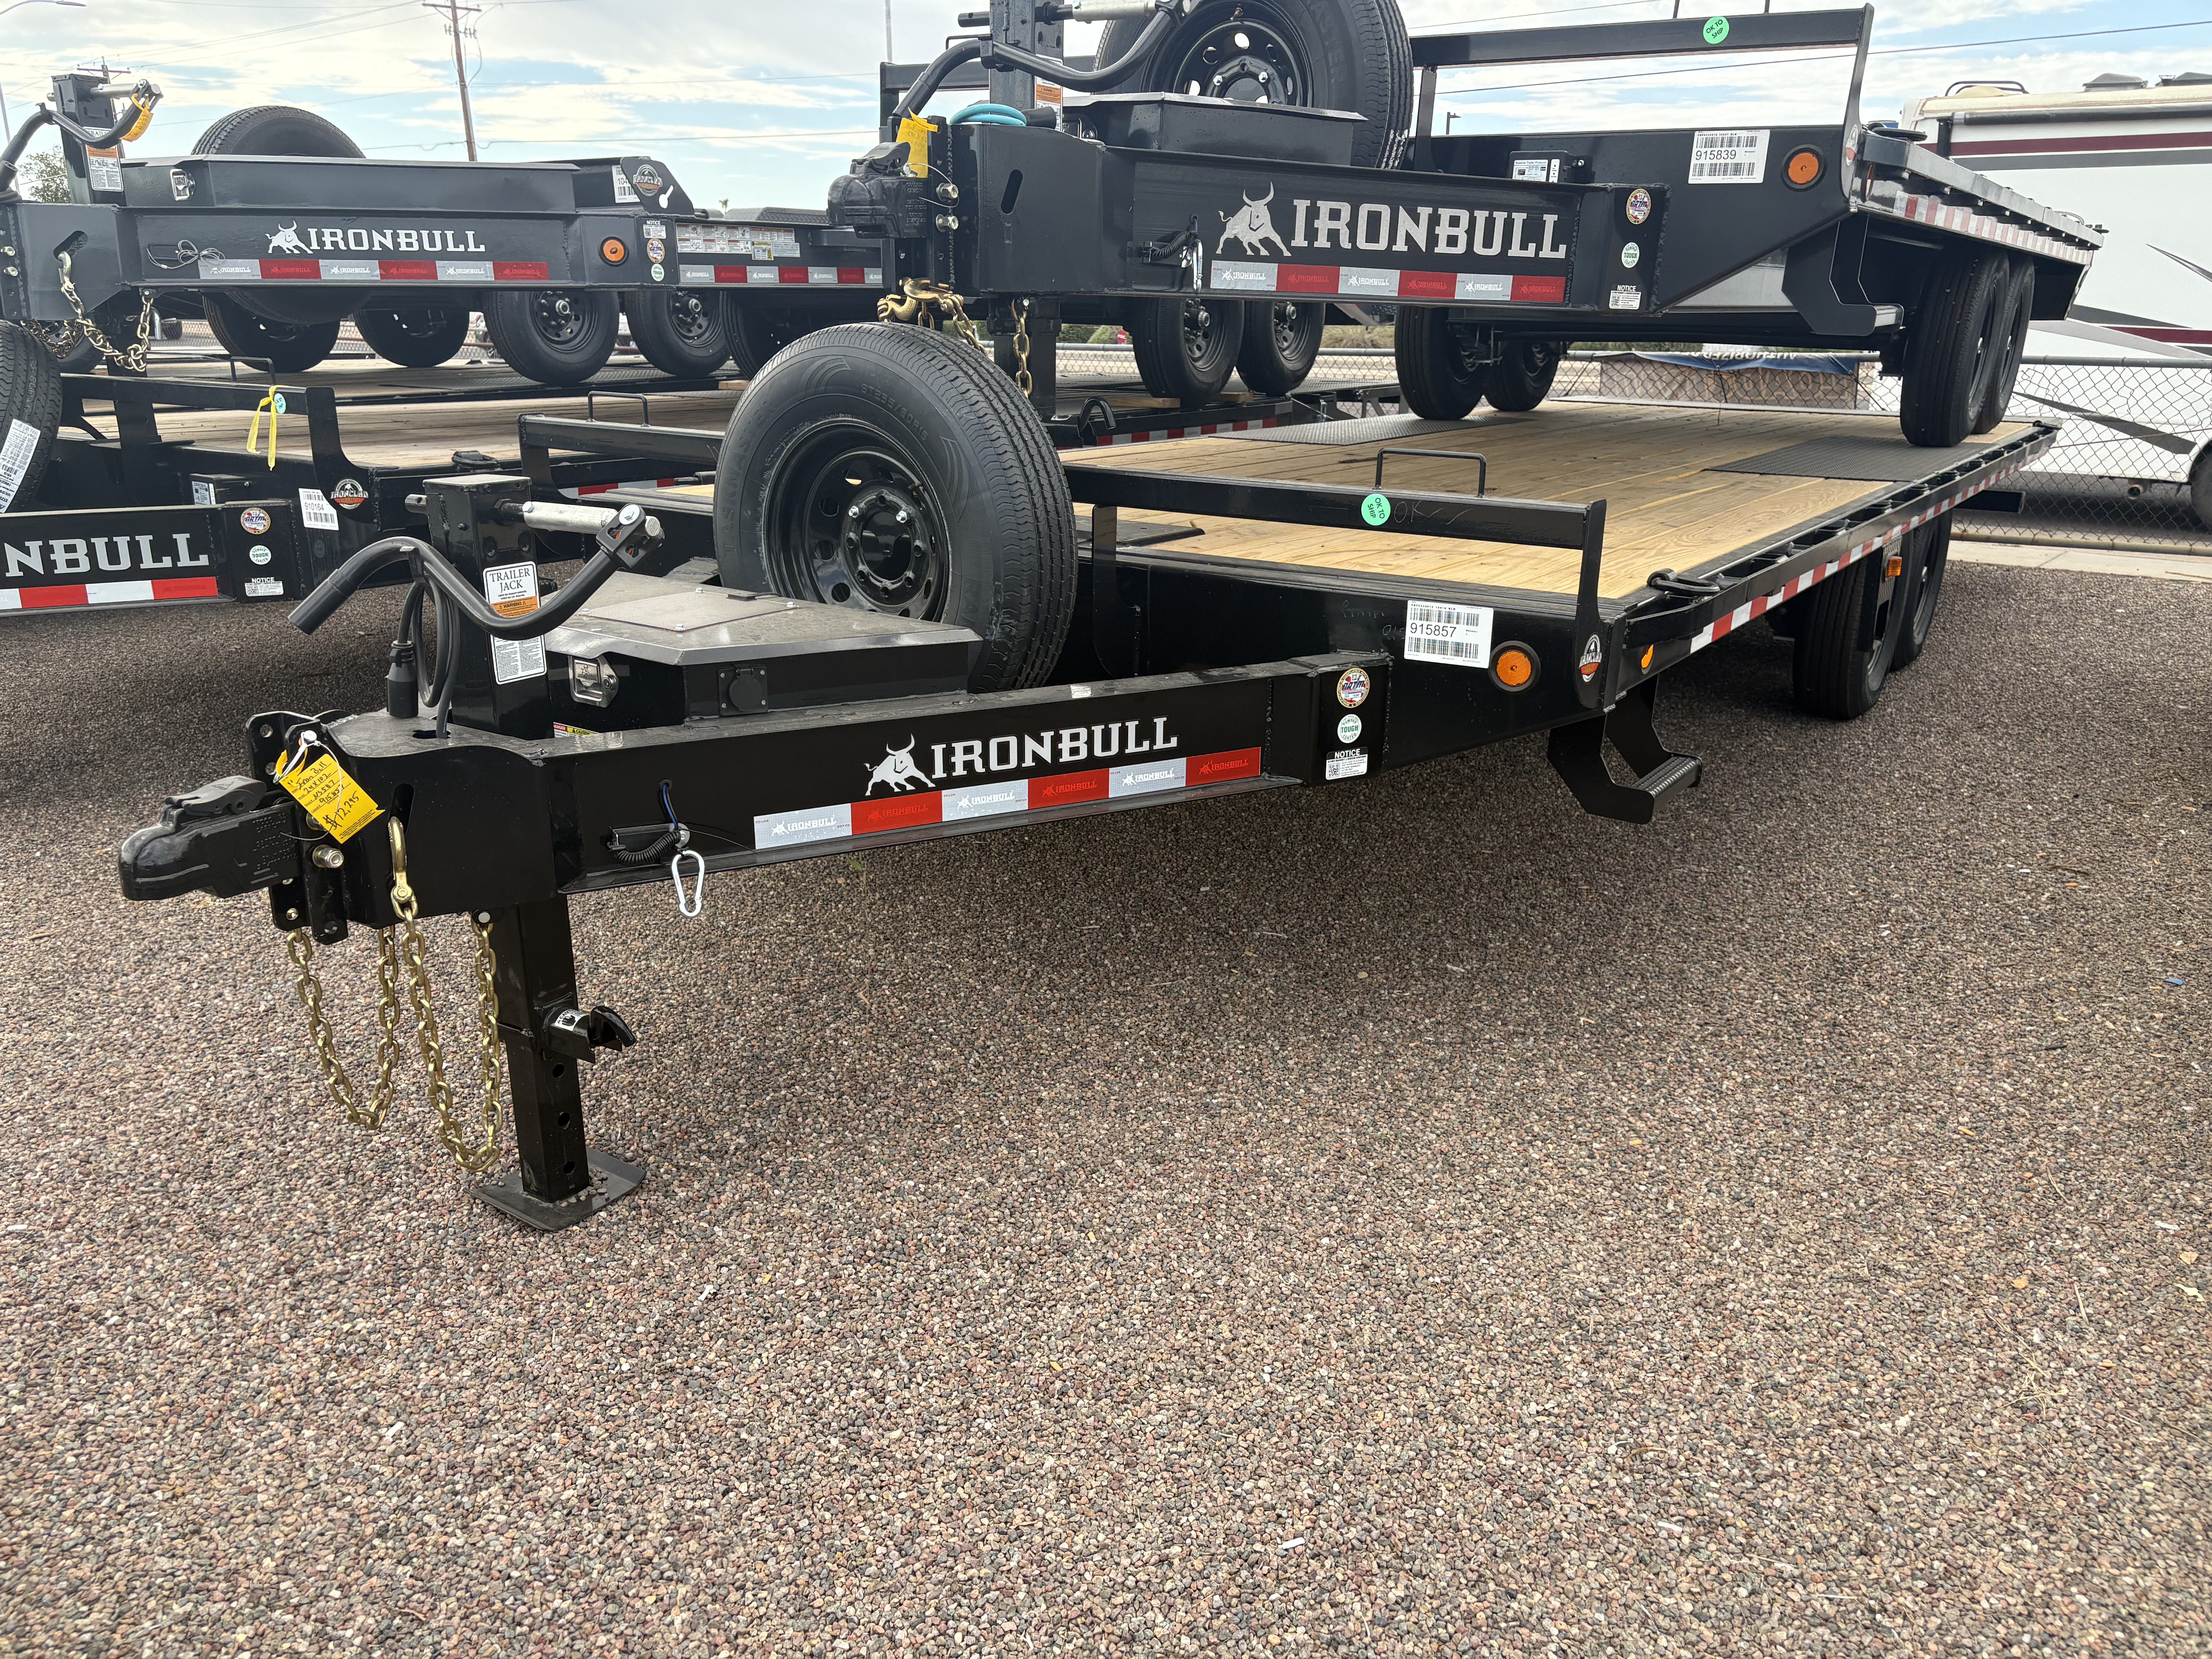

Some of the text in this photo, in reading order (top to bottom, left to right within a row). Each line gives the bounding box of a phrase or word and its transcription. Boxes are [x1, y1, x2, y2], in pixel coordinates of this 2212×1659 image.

[1706, 25, 1715, 33] OK
[1712, 27, 1723, 39] SHIP
[1695, 149, 1736, 160] 915839
[1291, 199, 1567, 259] IRONBULL
[307, 228, 486, 252] IRONBULL
[1358, 278, 1389, 286] IRONBULL
[330, 490, 369, 499] IRONCLAD
[304, 502, 324, 511] 910164
[1368, 504, 1376, 518] SHIP
[1375, 498, 1385, 519] OK TO
[4, 533, 209, 577] NBULL
[489, 568, 531, 582] TRAILER
[500, 579, 523, 593] JACK
[1410, 622, 1457, 638] 915857
[1343, 680, 1365, 690] NATM
[1340, 725, 1358, 733] TOUGH
[931, 717, 1178, 779] IRONBULL
[1334, 748, 1360, 759] NOTICE
[1211, 759, 1249, 771] IRONBULL
[1135, 769, 1175, 782] IRONBULL
[1055, 781, 1097, 793] IRONBULL
[971, 792, 1015, 804] IRONBULL
[882, 804, 929, 817] IRONBULL
[787, 817, 836, 831] IRONBULL
